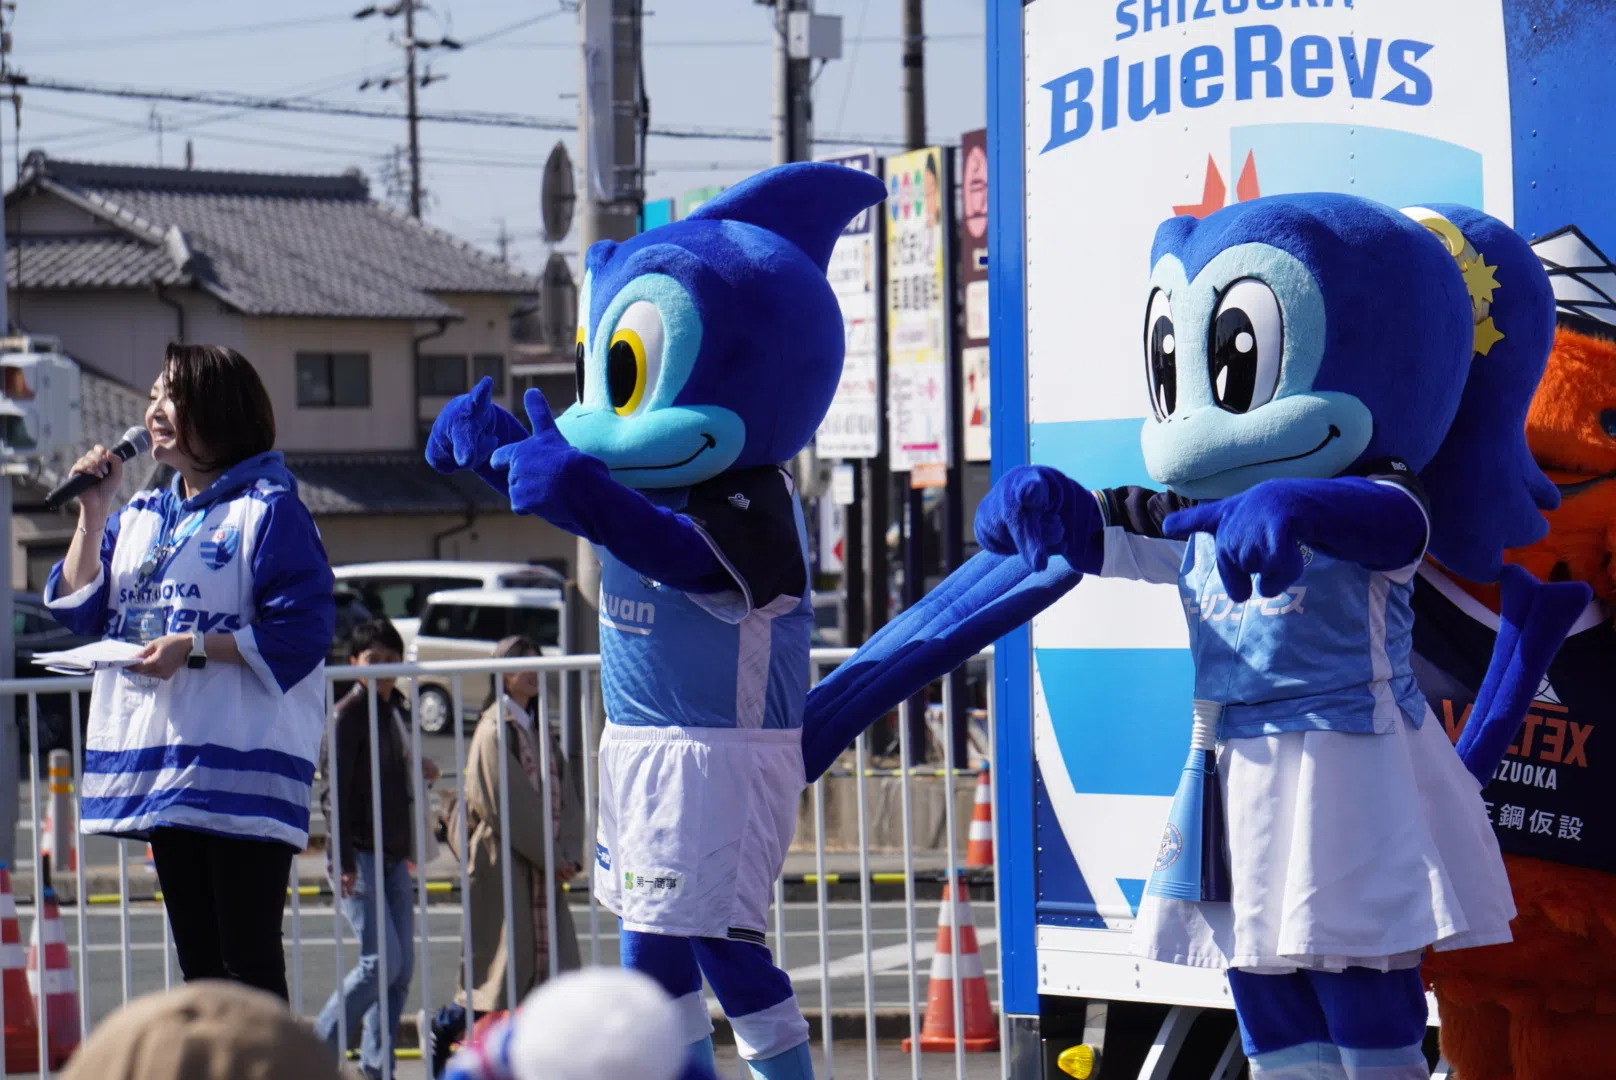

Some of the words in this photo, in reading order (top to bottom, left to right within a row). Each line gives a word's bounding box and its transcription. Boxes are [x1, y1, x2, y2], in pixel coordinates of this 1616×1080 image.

[1115, 0, 1355, 41] SHIZ
[1038, 24, 1435, 156] BlueRevs
[604, 592, 656, 624] uan
[1492, 759, 1558, 791] ZUOKA
